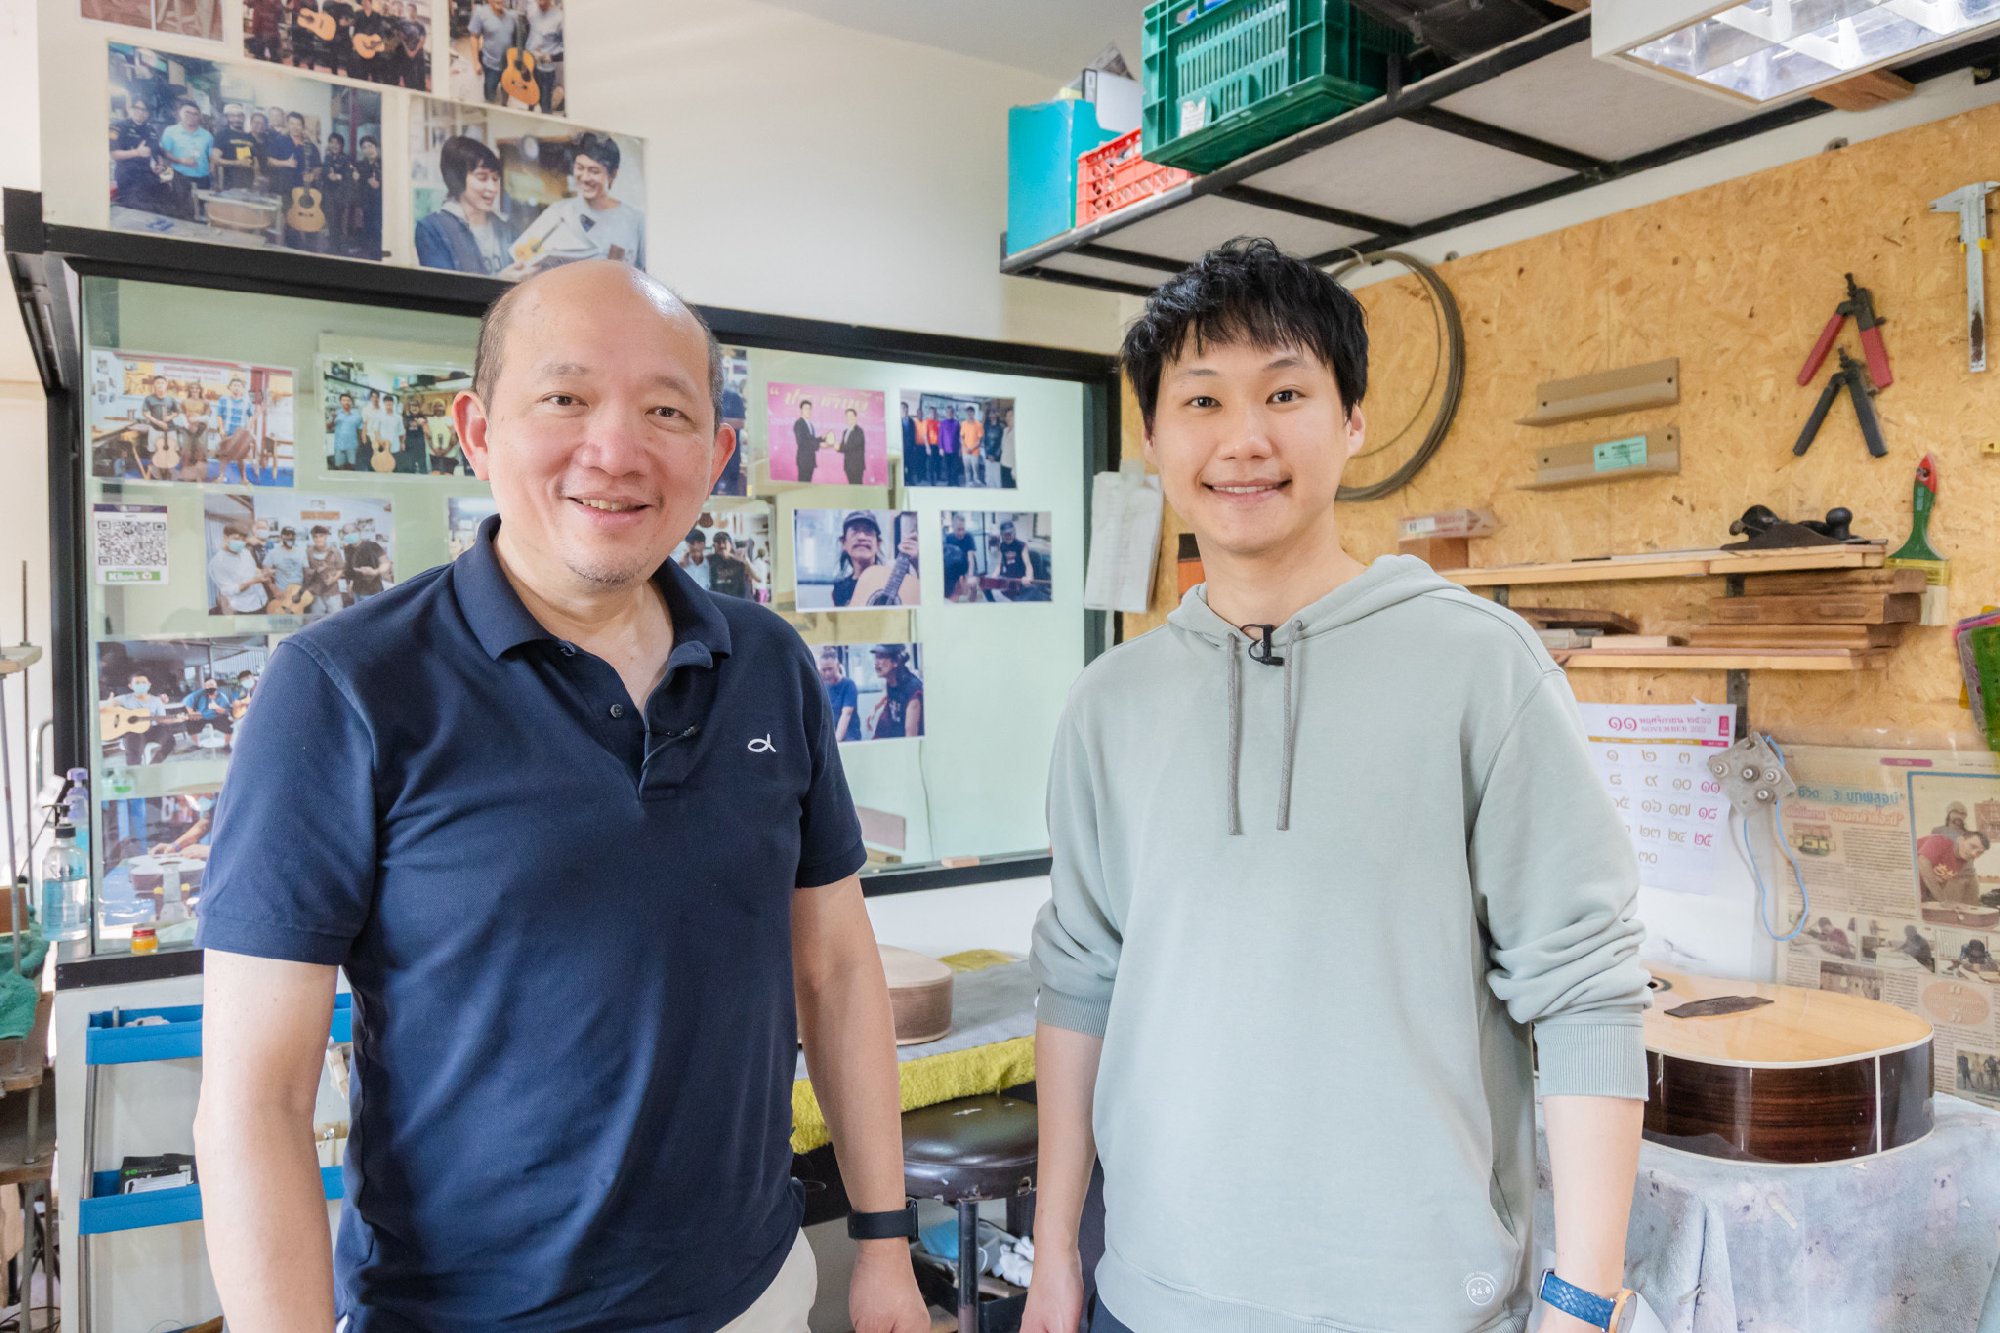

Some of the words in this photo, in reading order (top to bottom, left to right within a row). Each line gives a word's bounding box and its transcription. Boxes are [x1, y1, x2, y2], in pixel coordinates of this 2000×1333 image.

[1608, 716, 1637, 731] ๑๑
[1606, 750, 1619, 762] ๑
[1641, 750, 1657, 762] ๒
[1678, 752, 1691, 764] ๓
[1644, 774, 1658, 787] ๙
[1672, 778, 1692, 791] ๑๐
[1701, 781, 1721, 793] ๑๑
[1641, 799, 1662, 813] ๑๖
[1668, 803, 1691, 816] ๑๗
[1698, 807, 1718, 820] ๑๘
[1639, 825, 1661, 838] ๒๓
[1638, 851, 1658, 864] ๓๐
